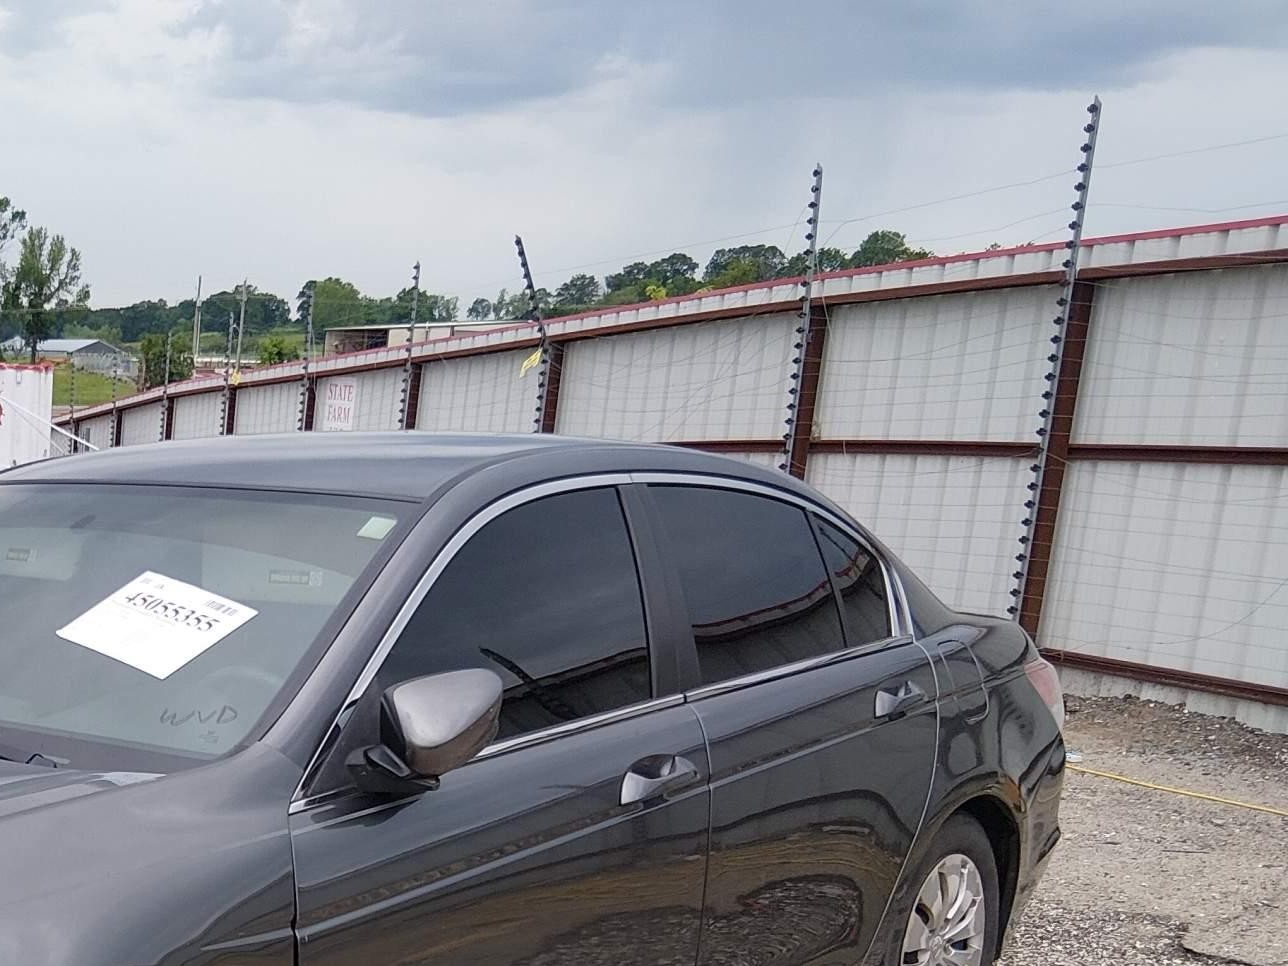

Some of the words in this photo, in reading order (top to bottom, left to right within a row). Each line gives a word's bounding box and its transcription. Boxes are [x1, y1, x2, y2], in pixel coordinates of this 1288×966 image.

[328, 383, 353, 402] STATE
[327, 405, 351, 424] FARM
[125, 592, 220, 631] 45055355
